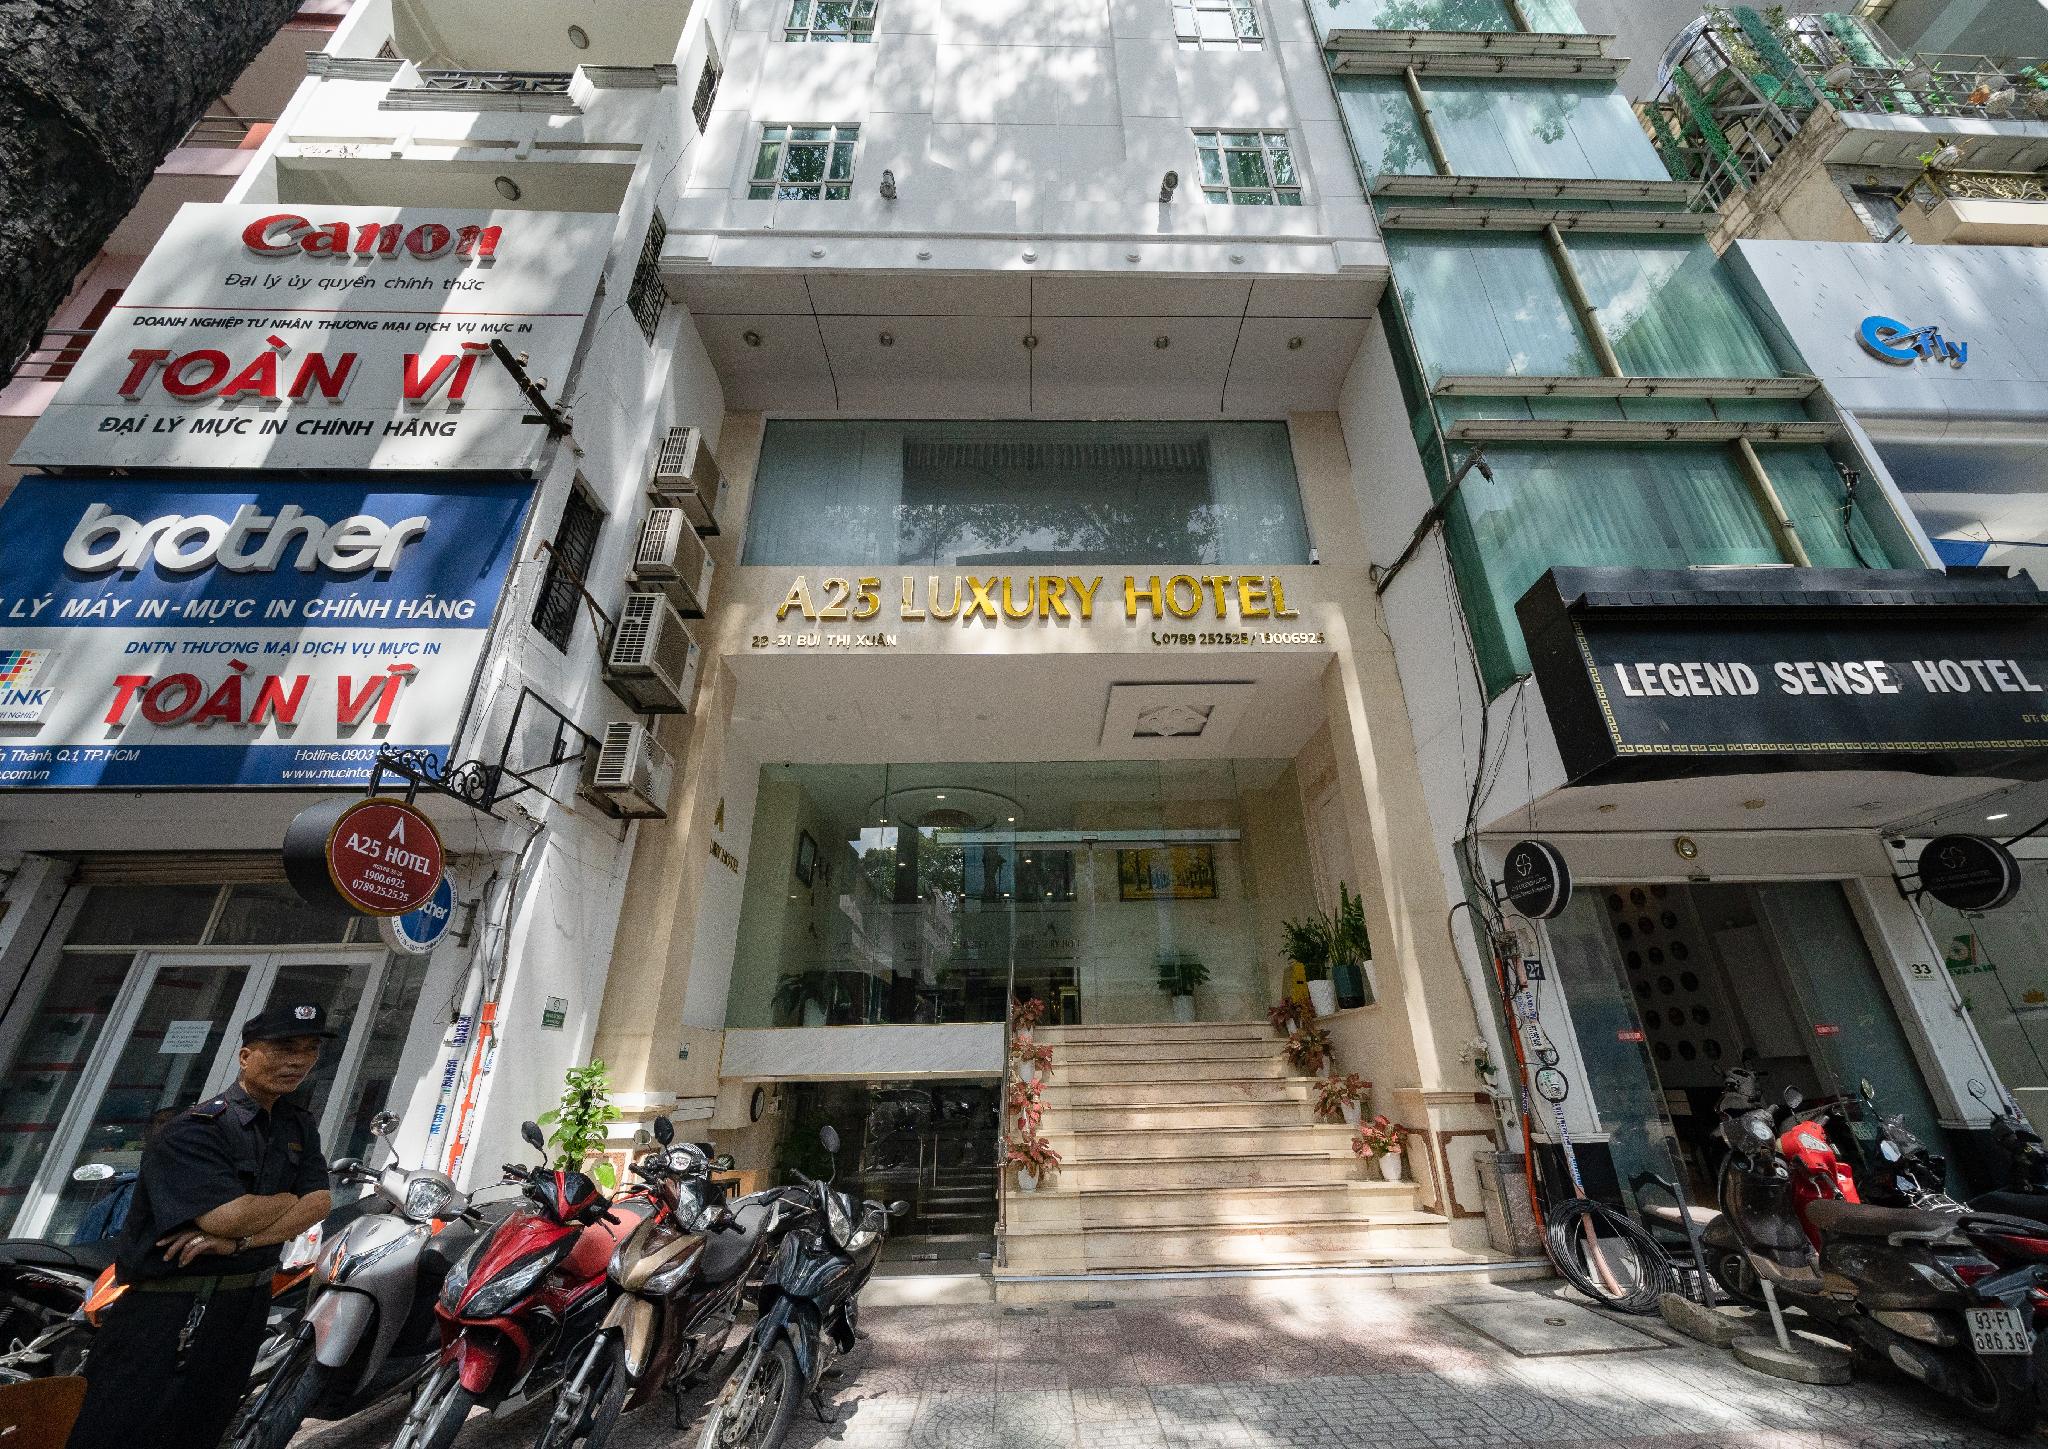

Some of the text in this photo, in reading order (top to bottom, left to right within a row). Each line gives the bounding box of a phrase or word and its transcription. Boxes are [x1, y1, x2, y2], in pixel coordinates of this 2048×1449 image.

[242, 213, 504, 262] Canon
[224, 273, 485, 291] Đại lý ủy quyền chính thức
[132, 316, 186, 327] DOANH
[189, 316, 244, 330] NGHIỆP
[270, 317, 313, 330] NHÂN
[318, 319, 379, 331] THƯƠNG
[382, 321, 411, 334] MẠI
[414, 322, 452, 335] DỊCH
[457, 322, 477, 335] VỤ
[480, 321, 514, 335] MỰC
[517, 324, 533, 333] IN
[117, 334, 361, 401] TOÀN
[152, 416, 186, 433] LÝ
[189, 416, 253, 437] MỰC
[258, 419, 288, 435] IN
[295, 417, 374, 436] CHÍNH
[382, 417, 458, 437] HÃNG
[63, 502, 432, 573] brother
[8, 592, 54, 618] LÝ
[60, 592, 133, 619] MÁY
[264, 599, 297, 619] IN
[302, 592, 392, 619] CHÍNH
[394, 593, 477, 620] HÃNG
[776, 574, 1301, 620] A25 LUXURY HOTEL
[124, 641, 442, 658] DNTN THƯƠNG MẠI DỊCH VỤ MỰC IN
[797, 633, 821, 648] BÙI
[827, 634, 850, 650] THỊ
[855, 632, 898, 648] XUÂN
[1162, 633, 1197, 646] 0789
[1613, 659, 2044, 697] LEGEND SENSE HOTEL
[104, 658, 313, 726] TOÀN
[83, 749, 141, 761] TP.HCM
[345, 832, 382, 858] A25
[384, 844, 431, 876] HOTEL
[363, 868, 406, 889] 1900.6925
[1526, 963, 1540, 978] 27
[1911, 963, 1932, 974] 33
